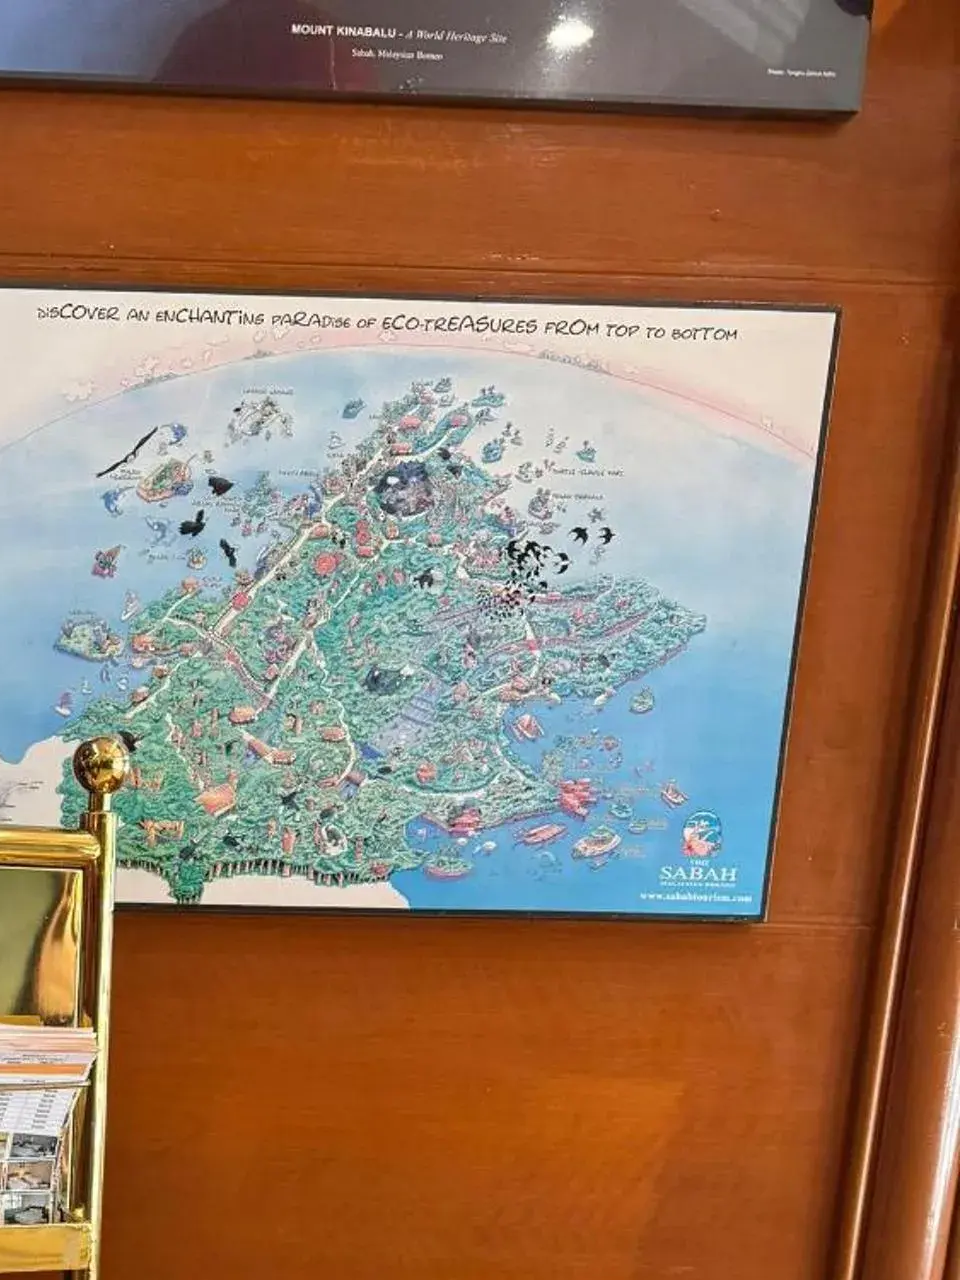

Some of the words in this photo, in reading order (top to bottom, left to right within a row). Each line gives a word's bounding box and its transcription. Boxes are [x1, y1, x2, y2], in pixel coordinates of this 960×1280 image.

[291, 24, 334, 36] MOUNT
[336, 26, 396, 38] KINABALU
[416, 30, 444, 41] World
[445, 31, 488, 44] Heritage
[489, 32, 508, 44] Site
[37, 303, 121, 321] DISCOVER
[126, 308, 150, 321] AN
[155, 309, 265, 326] ENCHANTING
[271, 312, 351, 329] PARADISE
[357, 317, 377, 329] OF
[382, 315, 538, 333] ECO-TREASURES
[544, 319, 600, 335] FROM
[606, 323, 641, 338] TOP
[646, 326, 666, 339] TO
[672, 326, 739, 341] BOTTOM
[658, 866, 738, 882] SABAH
